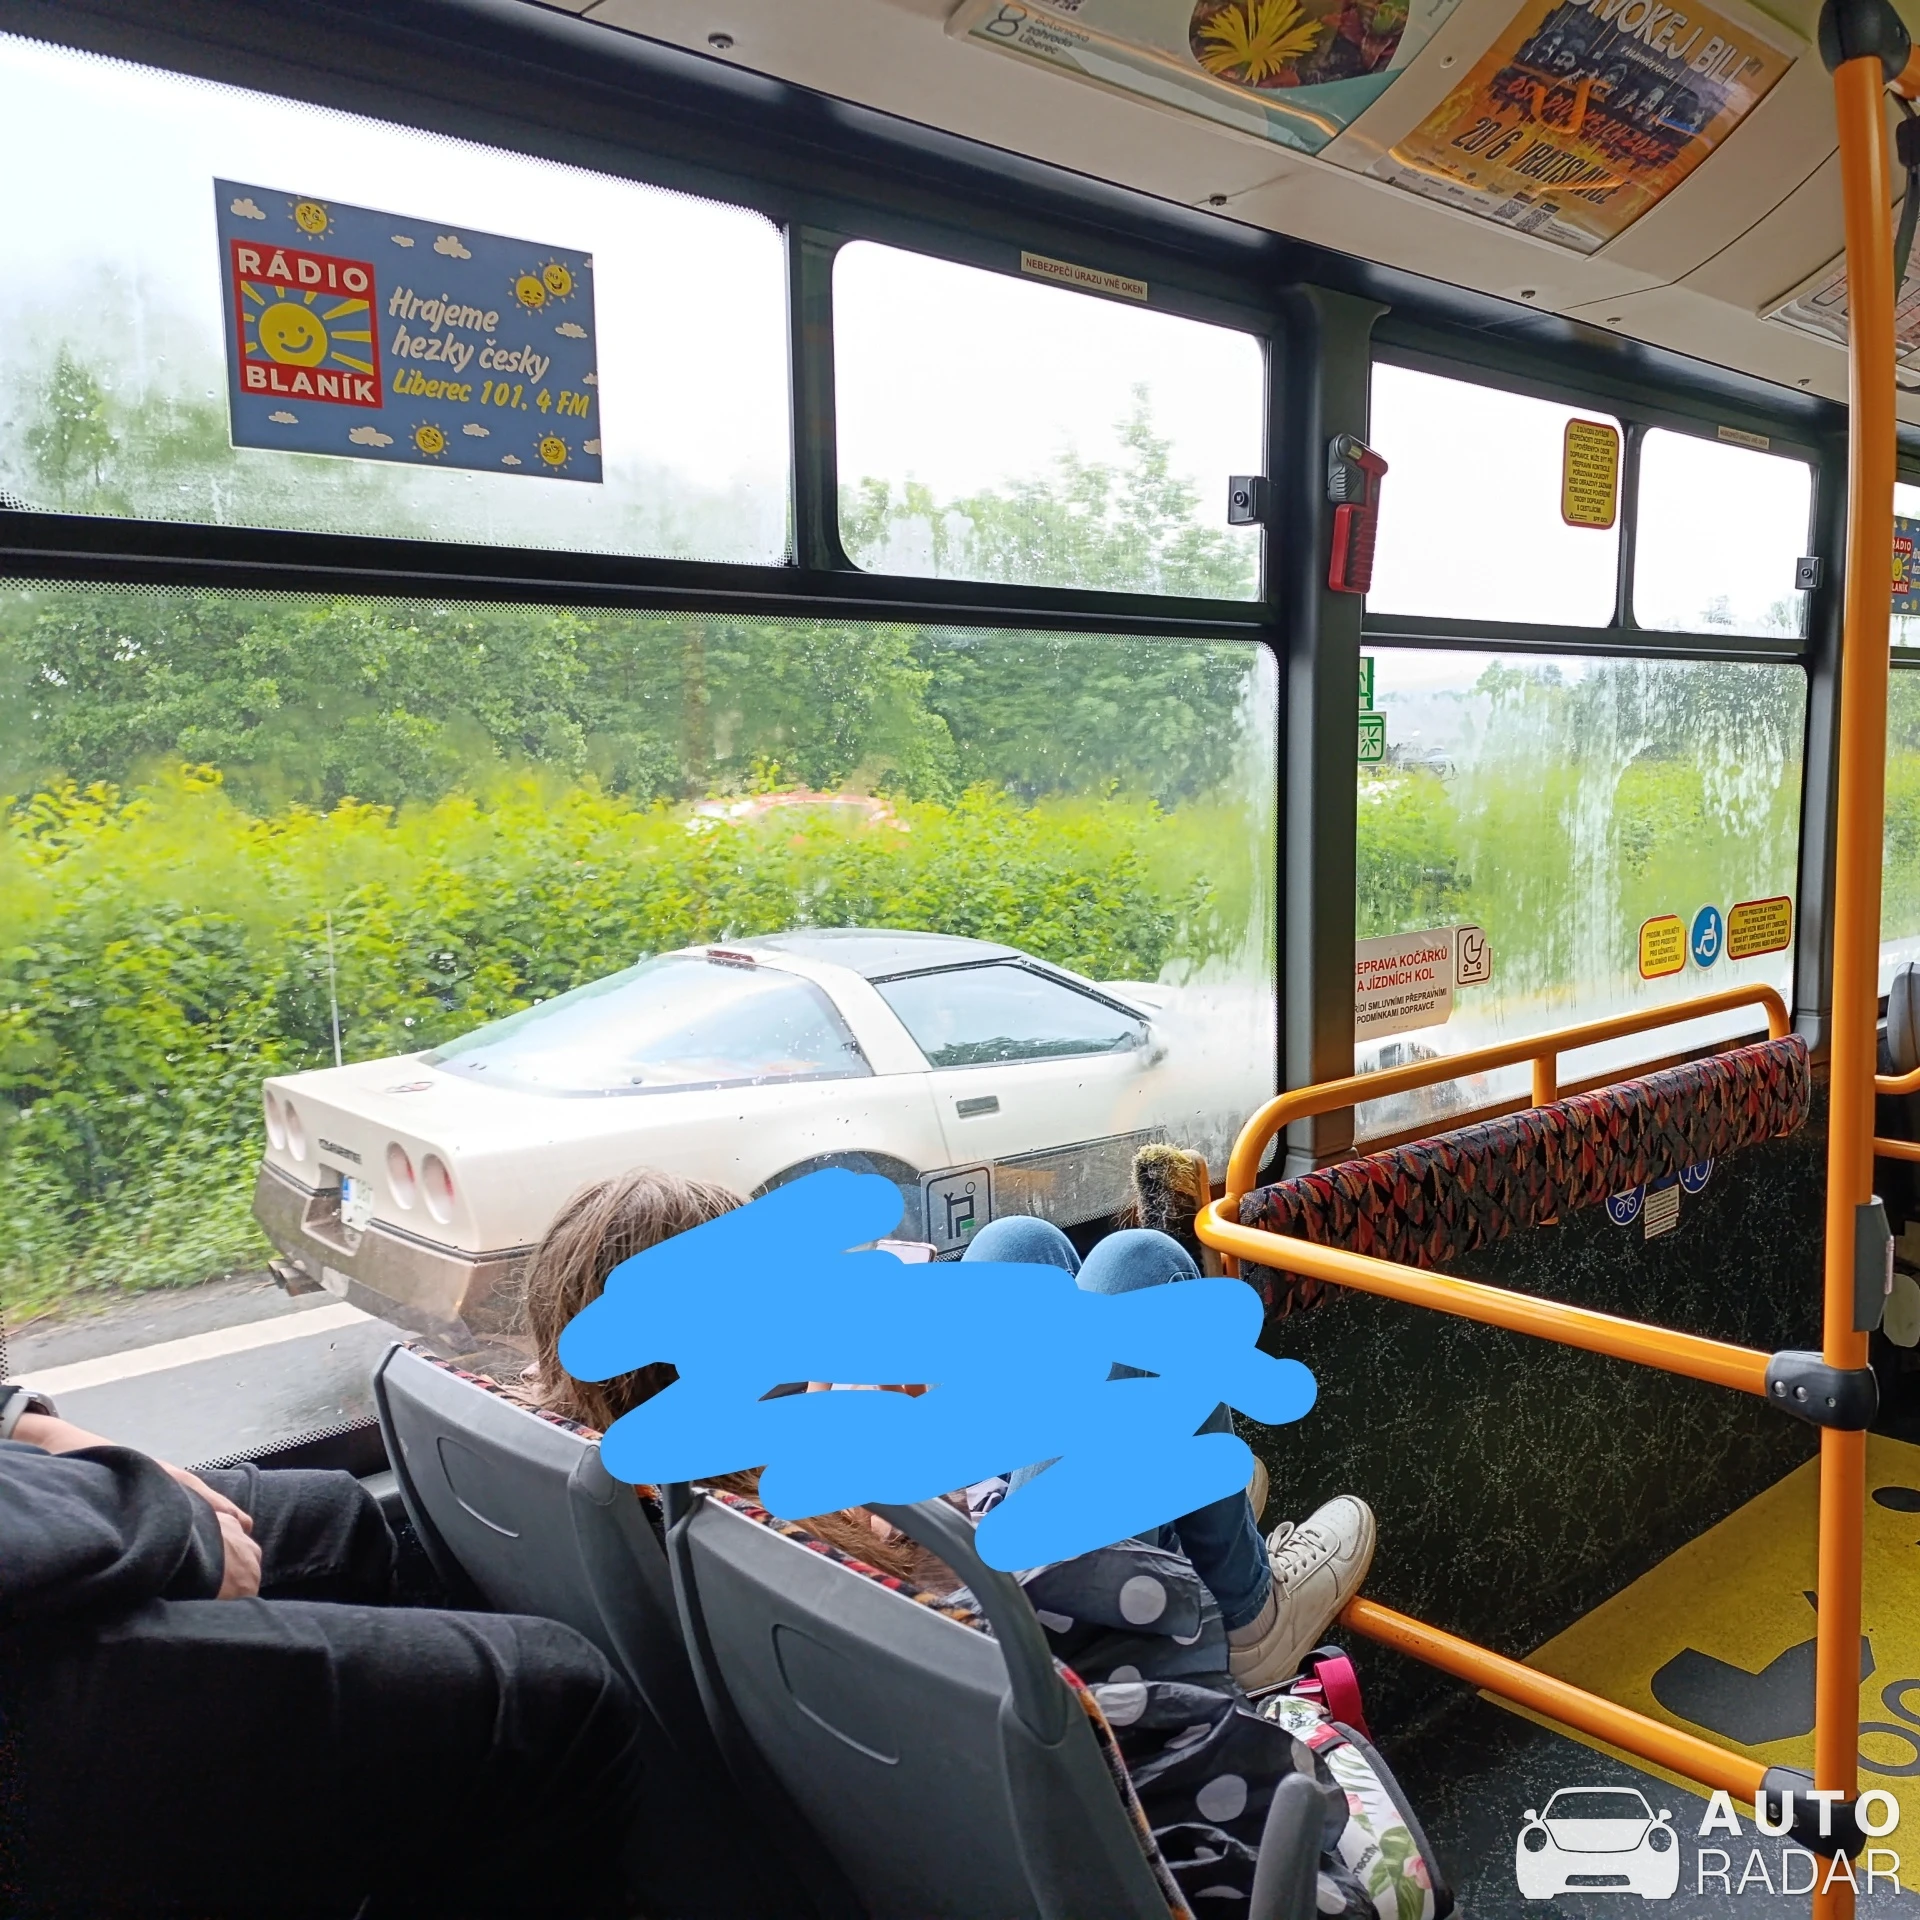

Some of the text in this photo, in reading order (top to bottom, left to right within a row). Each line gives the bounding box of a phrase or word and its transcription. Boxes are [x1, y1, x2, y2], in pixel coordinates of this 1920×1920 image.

[1018, 33, 1058, 54] Liberec
[1566, 0, 1750, 92] VOKEJ BILL
[1451, 116, 1524, 161] 20/6
[237, 247, 369, 293] RÁDIO
[1074, 268, 1102, 285] ÚRAZU
[1121, 282, 1143, 295] OKEN
[388, 286, 499, 333] Hrajeme
[391, 325, 551, 385] hezky česky
[246, 363, 375, 404] BLANÍK
[392, 369, 472, 404] Liberec
[536, 388, 551, 415] 4
[557, 389, 591, 419] FM
[1892, 581, 1909, 593] LANÍK
[1355, 946, 1448, 975] EPRAVA KOČÁRKŮ
[1357, 967, 1435, 992] A JÍZDNÍCH KOL
[1356, 1001, 1435, 1025] PODMÍNKAMI DOPRAVCE
[1368, 995, 1404, 1011] SMLUVNÍMI
[1405, 987, 1447, 1002] PŘEPRAVNÍMI
